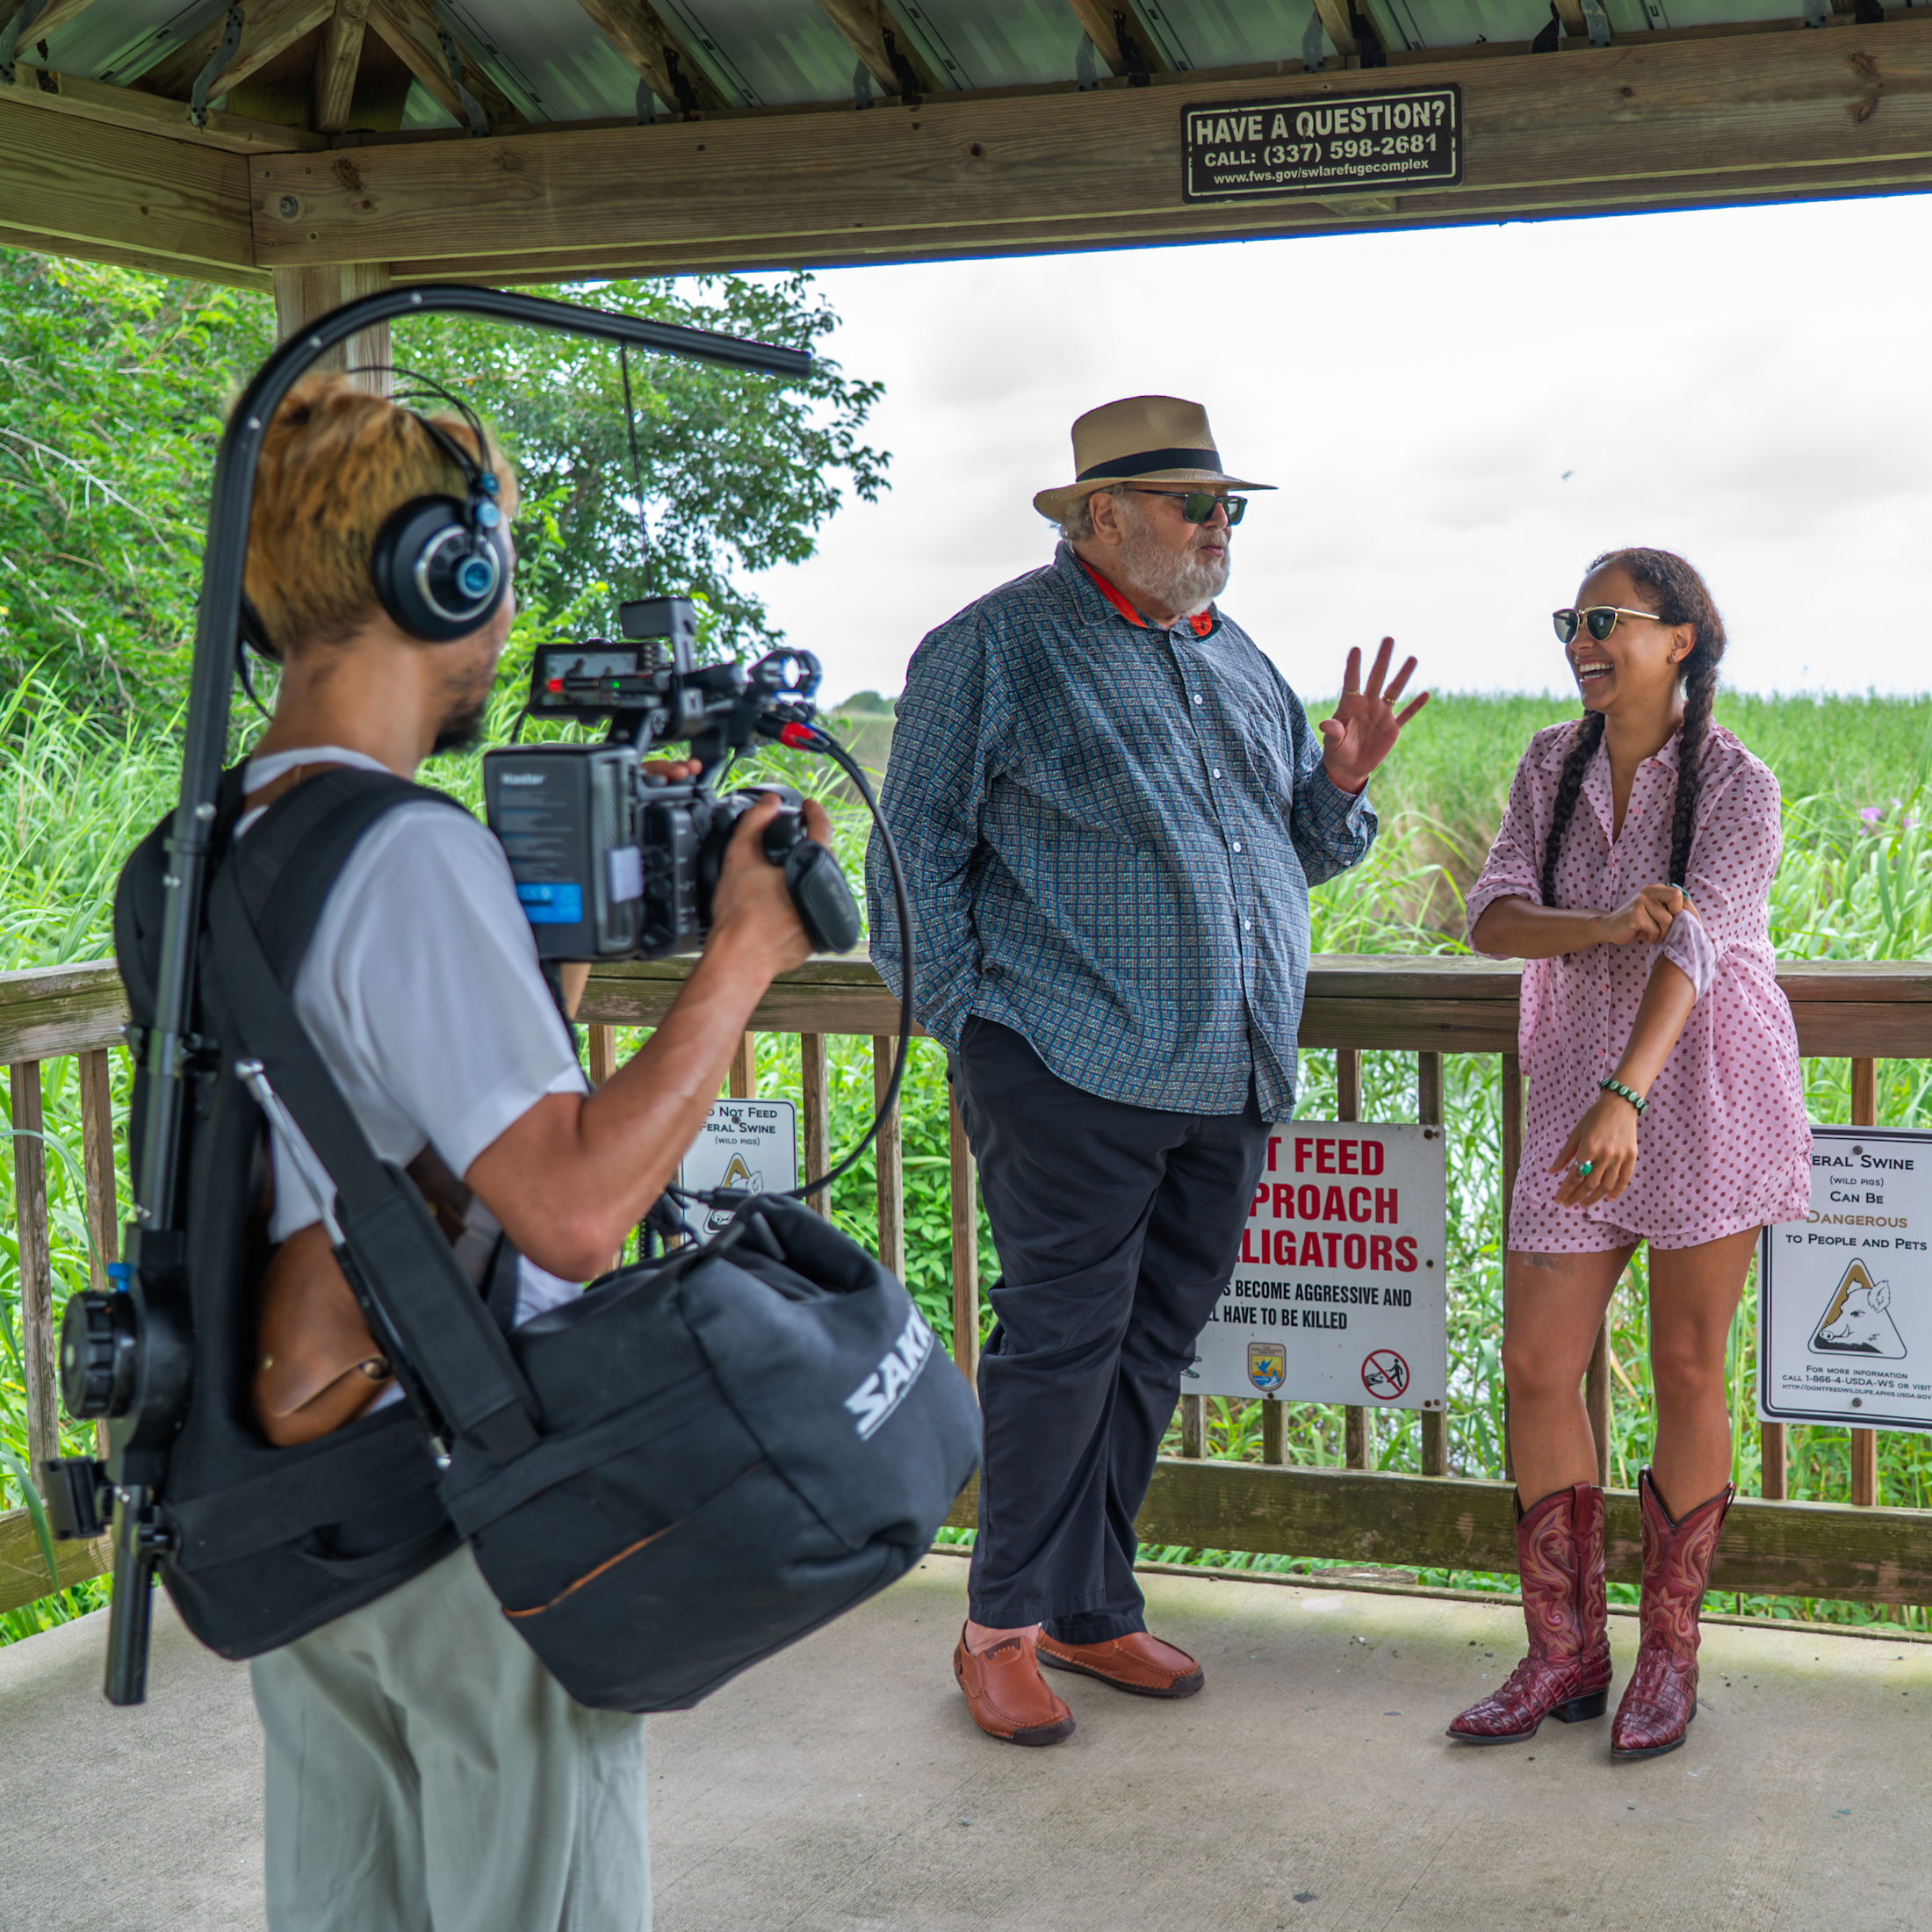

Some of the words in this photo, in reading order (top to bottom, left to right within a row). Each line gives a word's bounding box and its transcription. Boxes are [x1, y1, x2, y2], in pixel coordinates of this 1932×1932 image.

[1196, 115, 1263, 145] HAVE
[1271, 113, 1288, 139] A
[1296, 100, 1445, 138] QUESTION?
[1204, 150, 1256, 167] CALL:
[1264, 142, 1322, 166] (337)
[1330, 133, 1436, 159] 598-2681
[1214, 158, 1429, 184] www.fws.gov/swlarefugecomplex
[719, 1107, 744, 1118] NOT
[748, 1107, 778, 1118] FEED
[739, 1122, 775, 1134] SWINE
[715, 1135, 738, 1145] (WILD
[740, 1136, 761, 1147] PIGS)
[1294, 1137, 1384, 1176] FEED
[1811, 1156, 1853, 1167] ERAL
[1860, 1154, 1914, 1170] SWINE
[1829, 1175, 1856, 1186] (WILD
[1861, 1178, 1884, 1187] PIGS)
[1249, 1182, 1398, 1224] PROACH
[1830, 1191, 1860, 1203] CAN
[1865, 1193, 1884, 1204] BE
[1236, 1228, 1418, 1272] LIGATORS
[1785, 1235, 1802, 1244] TO
[1808, 1233, 1856, 1246] PEOPLE
[1862, 1238, 1889, 1248] AND
[1895, 1237, 1928, 1251] PETS
[1236, 1280, 1291, 1300] BECOME
[1294, 1283, 1379, 1305] AGGRESSIVE
[1383, 1287, 1412, 1307] AND
[1223, 1305, 1257, 1324] HAVE
[1260, 1308, 1277, 1325] TO
[1281, 1308, 1298, 1327] BE
[1302, 1309, 1347, 1330] KILLED
[1806, 1374, 1894, 1388] 1-866-4-USDA-WS
[1853, 1369, 1907, 1379] INFORMATION
